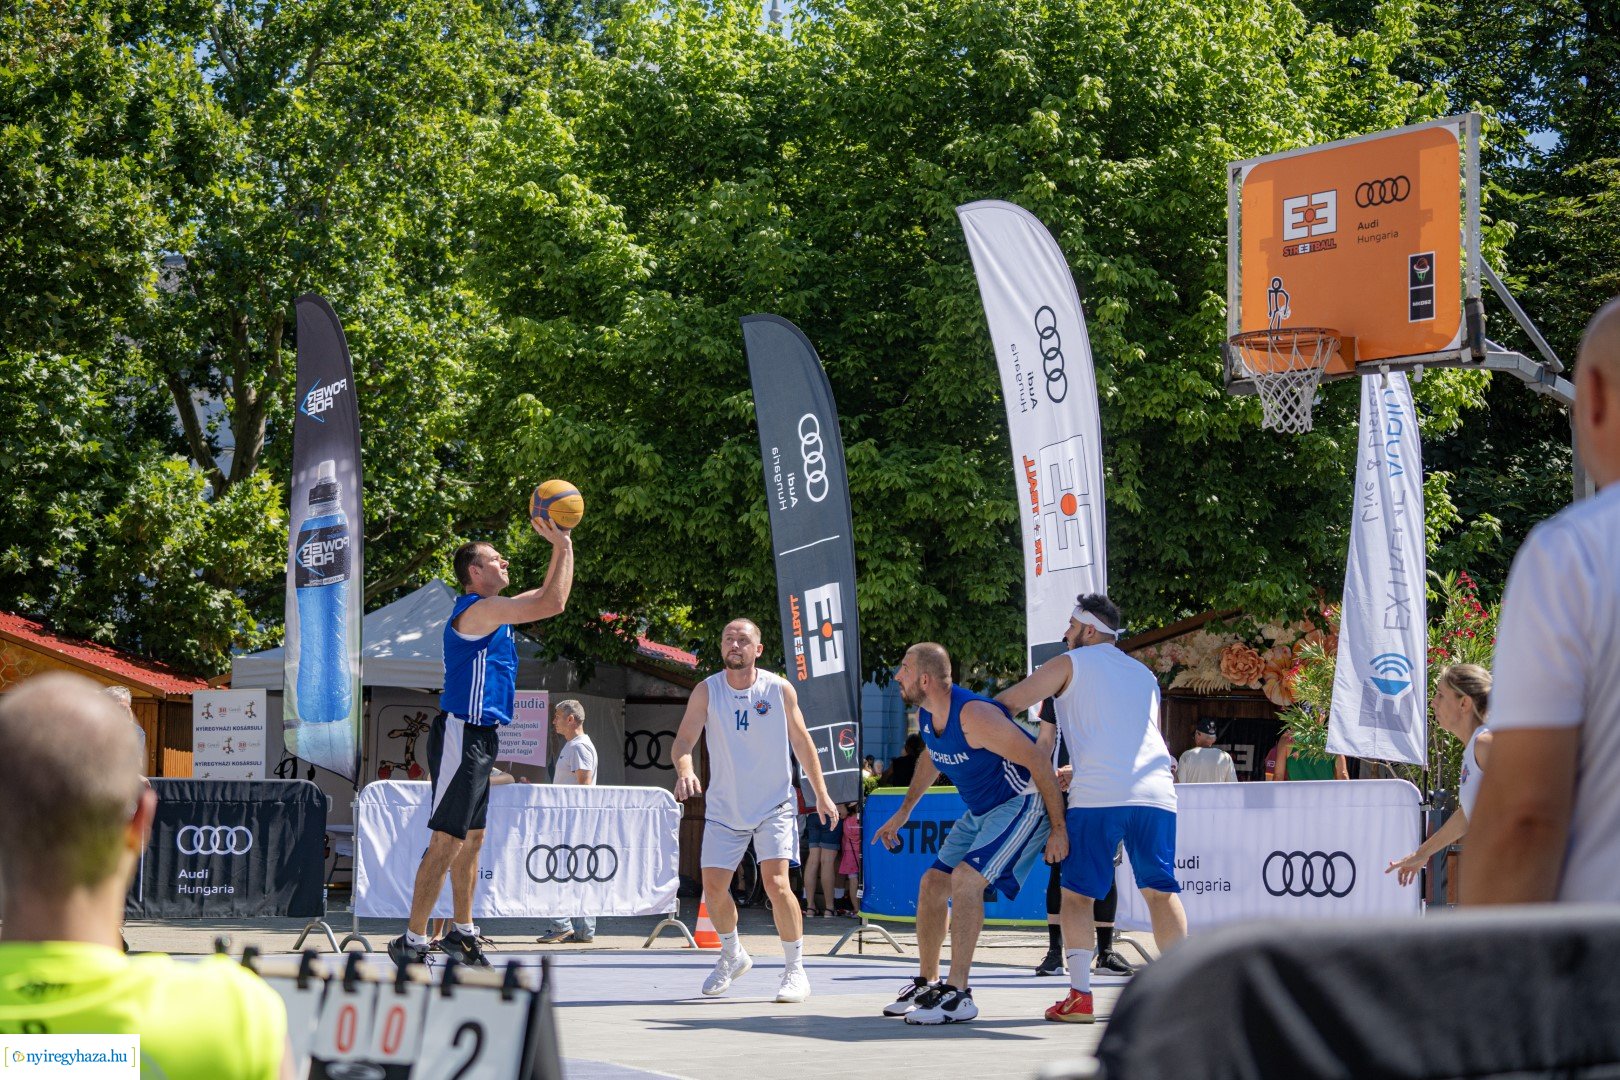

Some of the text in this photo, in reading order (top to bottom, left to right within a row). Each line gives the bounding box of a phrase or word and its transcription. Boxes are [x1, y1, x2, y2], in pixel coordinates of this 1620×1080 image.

[1357, 219, 1379, 231] Audi
[1357, 230, 1399, 244] Hungaria
[513, 697, 545, 709] audia
[734, 709, 749, 731] 14
[1174, 856, 1200, 869] udi
[178, 868, 209, 879] Audi
[178, 884, 235, 896] Hungaria
[1179, 878, 1231, 895] ungaria
[336, 1003, 484, 1080] 0 0 2
